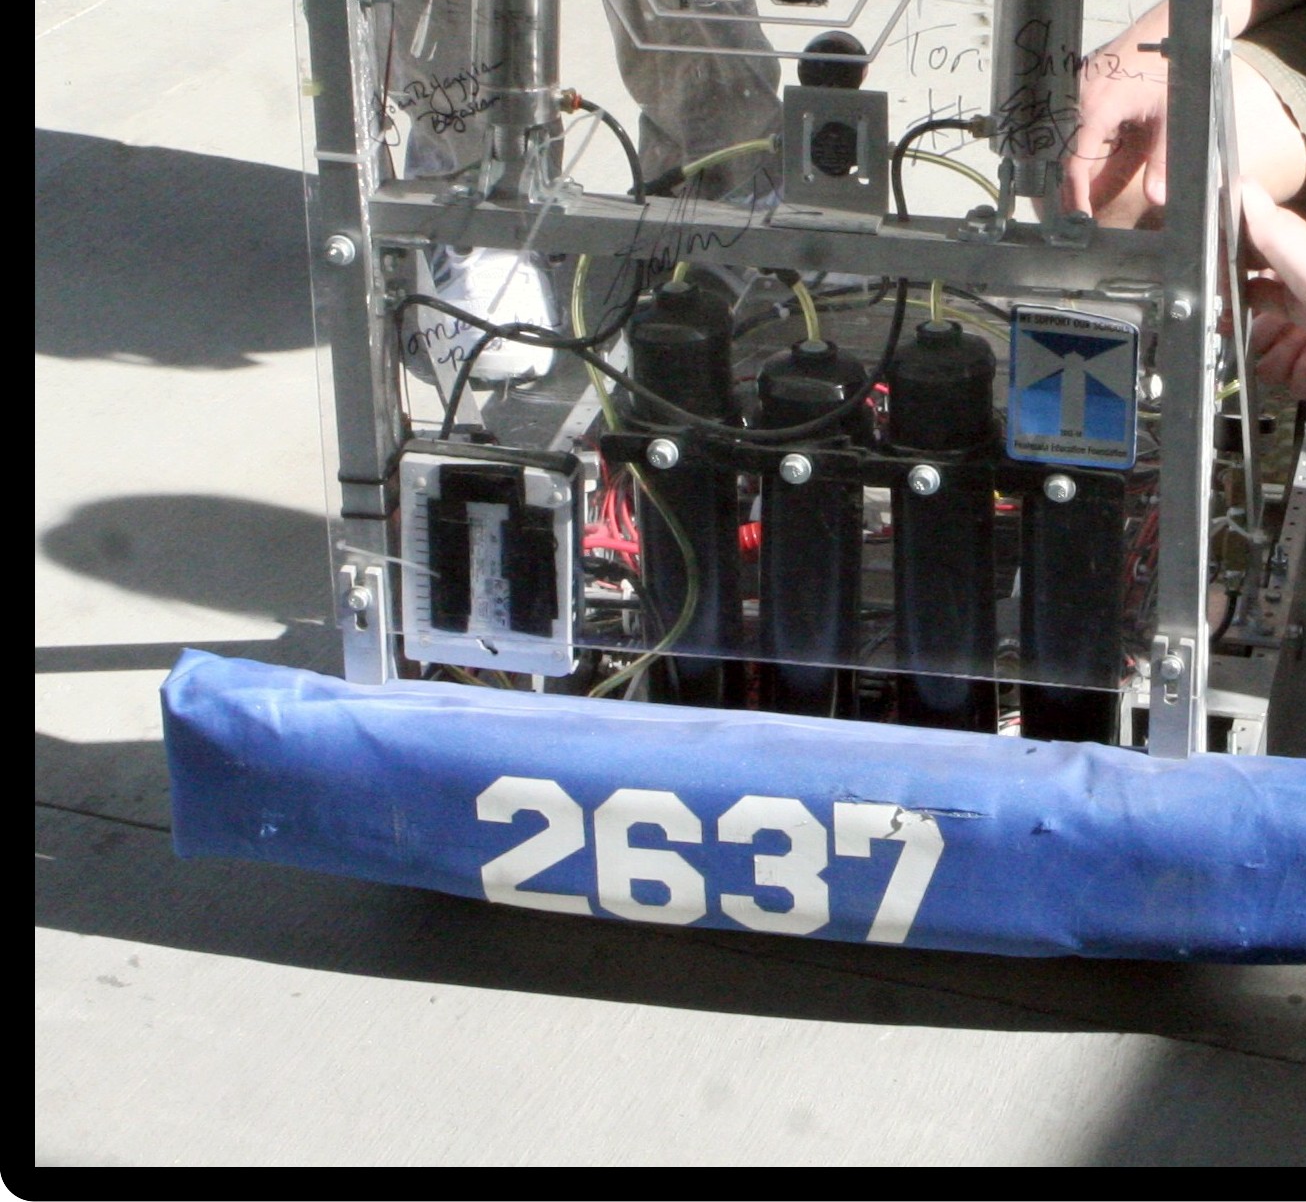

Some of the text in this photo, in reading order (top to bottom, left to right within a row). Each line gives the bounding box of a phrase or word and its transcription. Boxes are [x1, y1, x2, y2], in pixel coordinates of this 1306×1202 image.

[888, 23, 984, 77] Tori
[1034, 313, 1070, 326] SUPPORT
[475, 775, 945, 944] 2637
